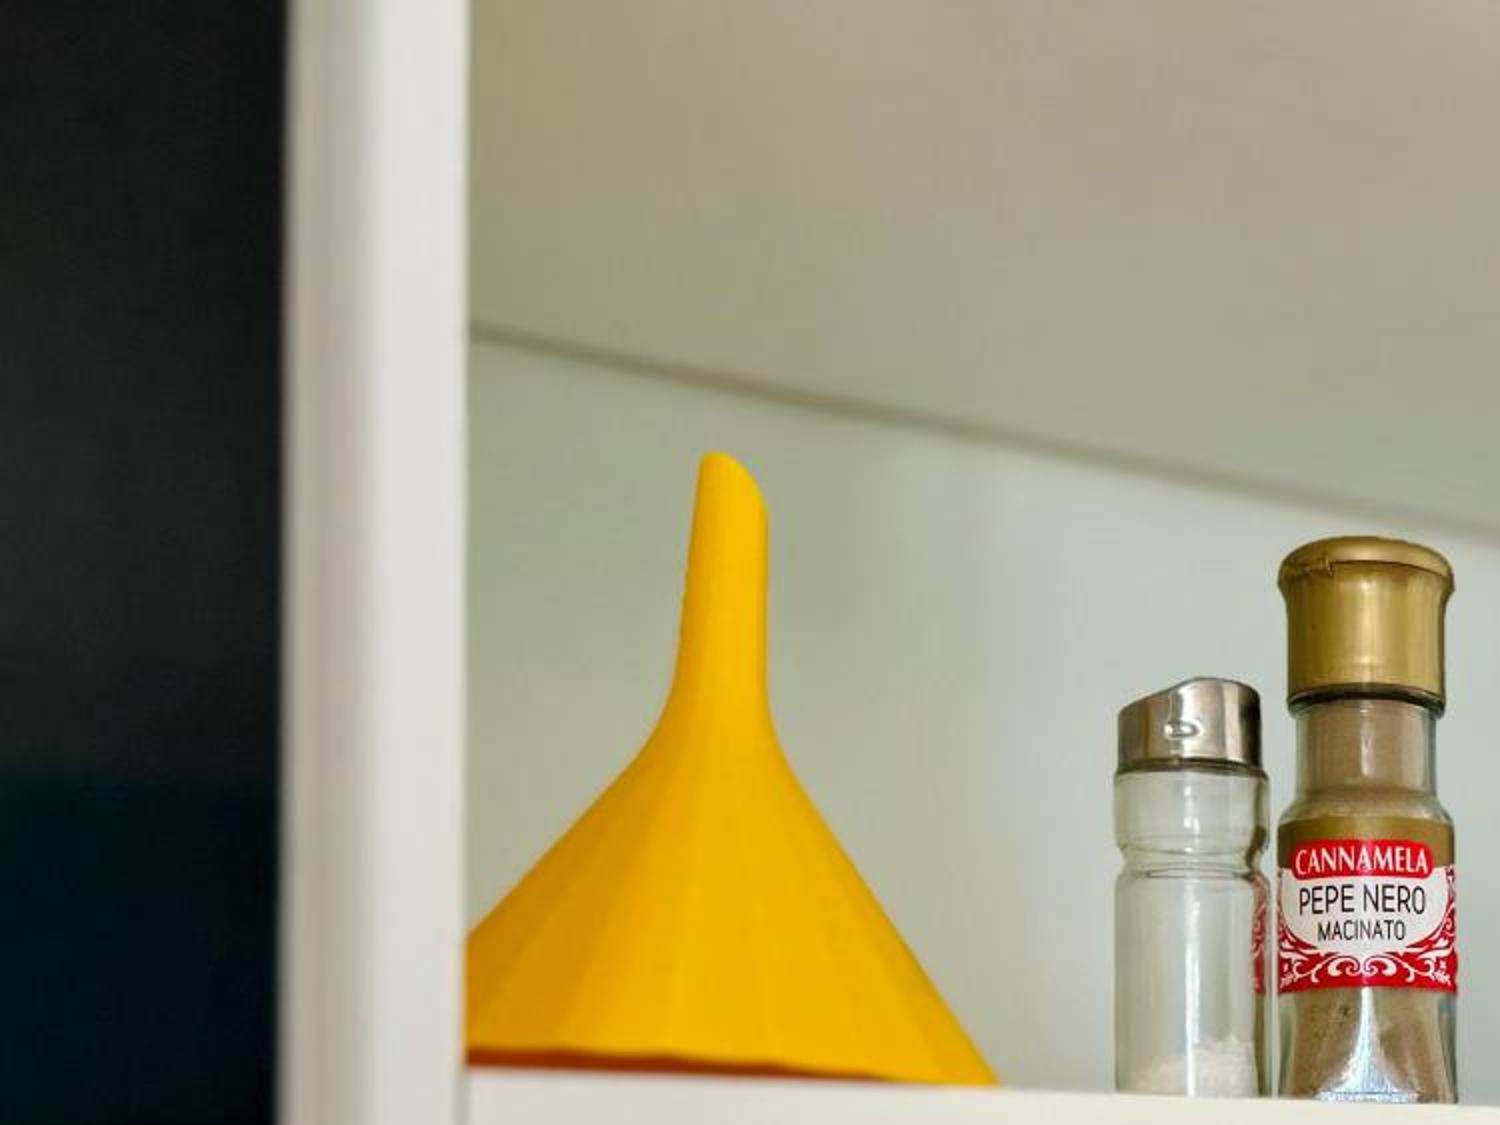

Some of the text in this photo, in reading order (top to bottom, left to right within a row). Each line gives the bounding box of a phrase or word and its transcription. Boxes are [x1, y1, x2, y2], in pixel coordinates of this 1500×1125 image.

[1295, 845, 1429, 876] CANNAMELA
[1299, 883, 1426, 915] PEPE NERO
[1316, 918, 1406, 942] MACINATO
